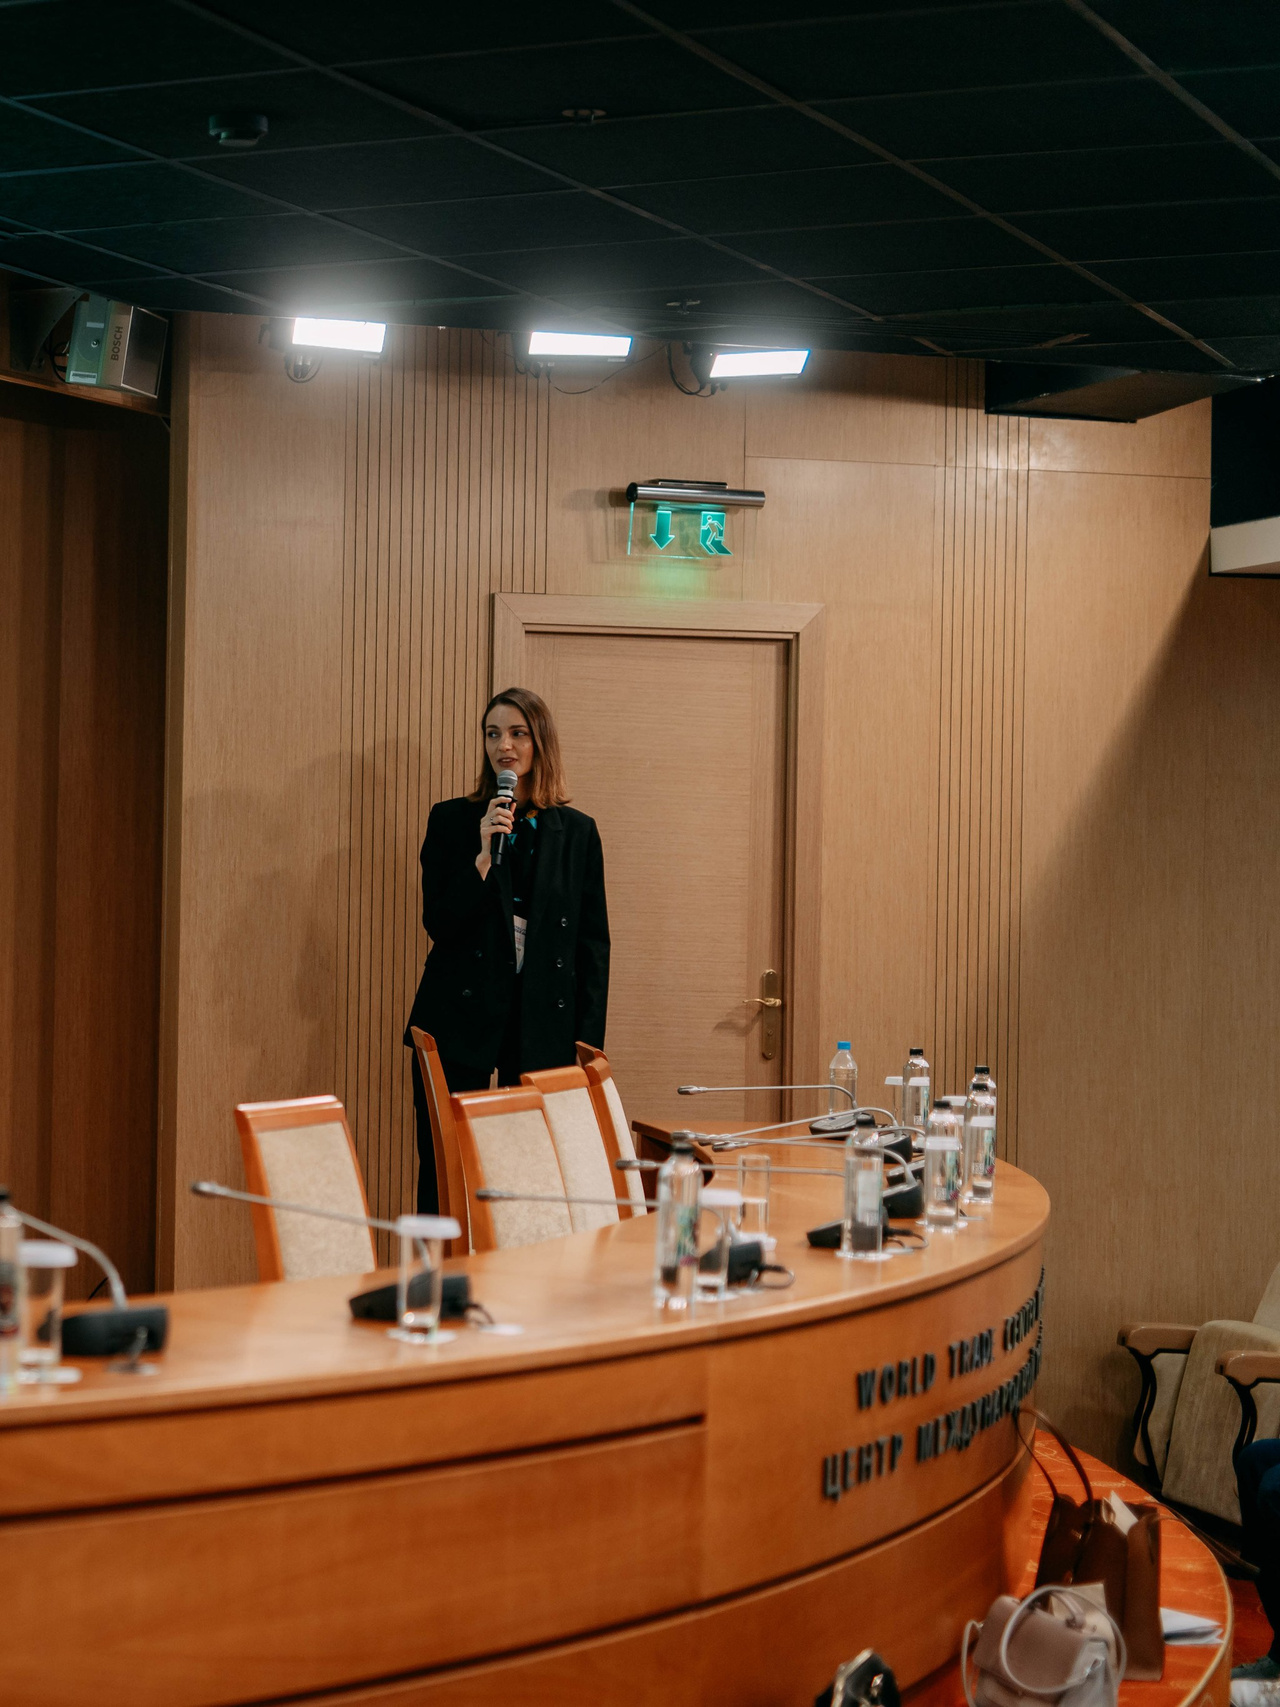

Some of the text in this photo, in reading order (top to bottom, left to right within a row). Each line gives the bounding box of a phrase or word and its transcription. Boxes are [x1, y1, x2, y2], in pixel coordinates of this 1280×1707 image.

[111, 326, 124, 361] BOSCH
[857, 1352, 936, 1411] WORLD
[823, 1433, 903, 1502] ЦЕНТР
